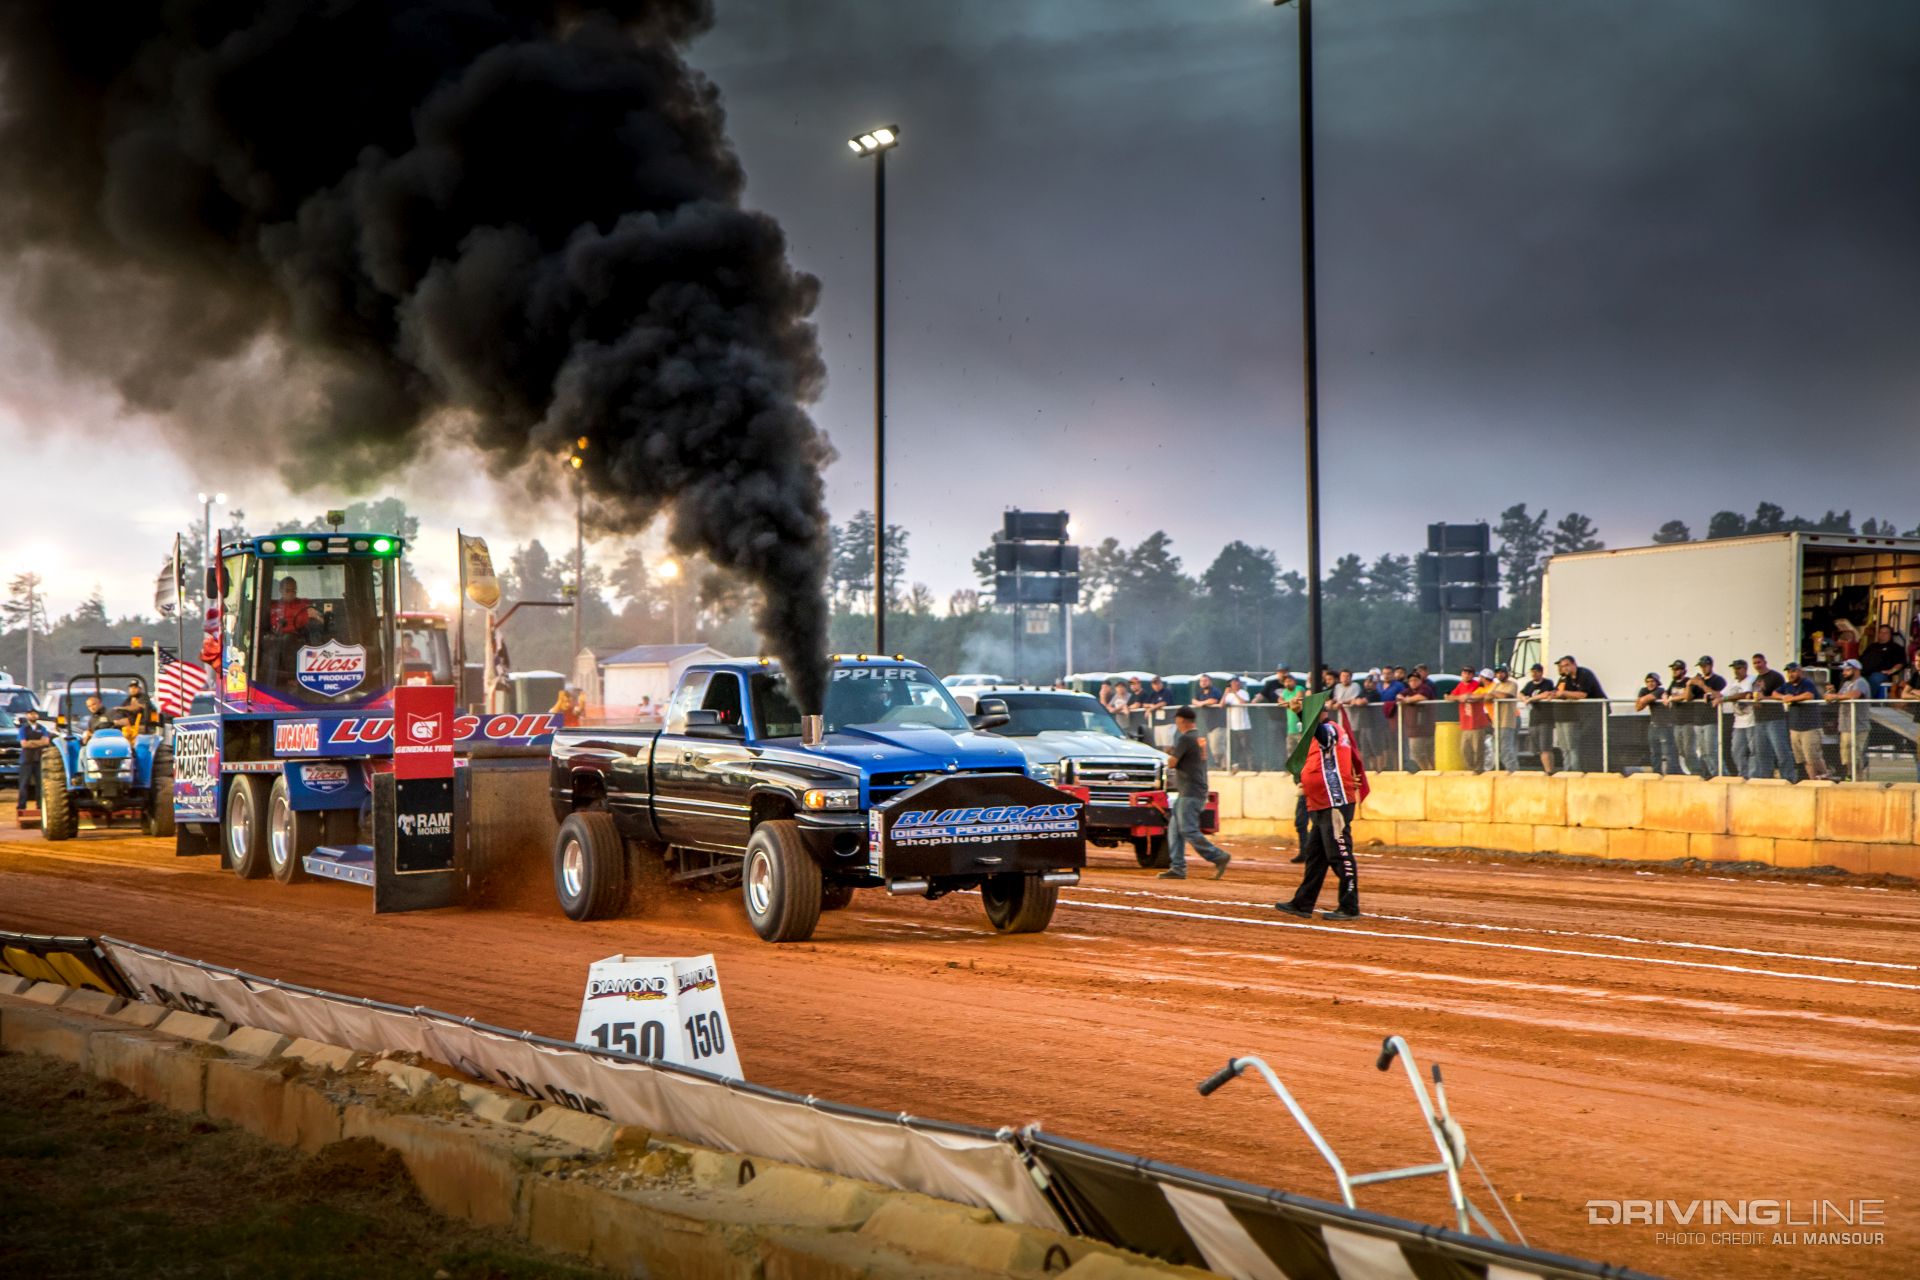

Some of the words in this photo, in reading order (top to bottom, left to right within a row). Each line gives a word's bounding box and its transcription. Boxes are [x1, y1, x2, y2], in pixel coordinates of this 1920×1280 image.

[305, 657, 362, 672] LUCAS
[301, 674, 316, 682] OIL
[318, 673, 362, 681] PRODUCTS
[832, 668, 917, 682] PPLER
[483, 714, 556, 740] OIL
[176, 731, 216, 757] DECISION
[275, 724, 303, 752] LUCAS
[303, 723, 319, 751] OIL
[395, 745, 434, 754] GENERAL
[433, 744, 453, 753] TIRE
[176, 756, 208, 781] MAKER
[417, 812, 450, 828] RAM
[892, 803, 1083, 828] BLUEGRASS
[417, 826, 450, 836] MOUNTS
[894, 827, 950, 839] DIESEL
[955, 820, 1076, 836] PERFORMANCE
[895, 830, 1079, 847] shopbluegrass.com
[589, 976, 668, 996] DIAMOND
[677, 965, 715, 990] DIAMOND
[591, 1020, 665, 1063] 150
[684, 1010, 726, 1060] 150
